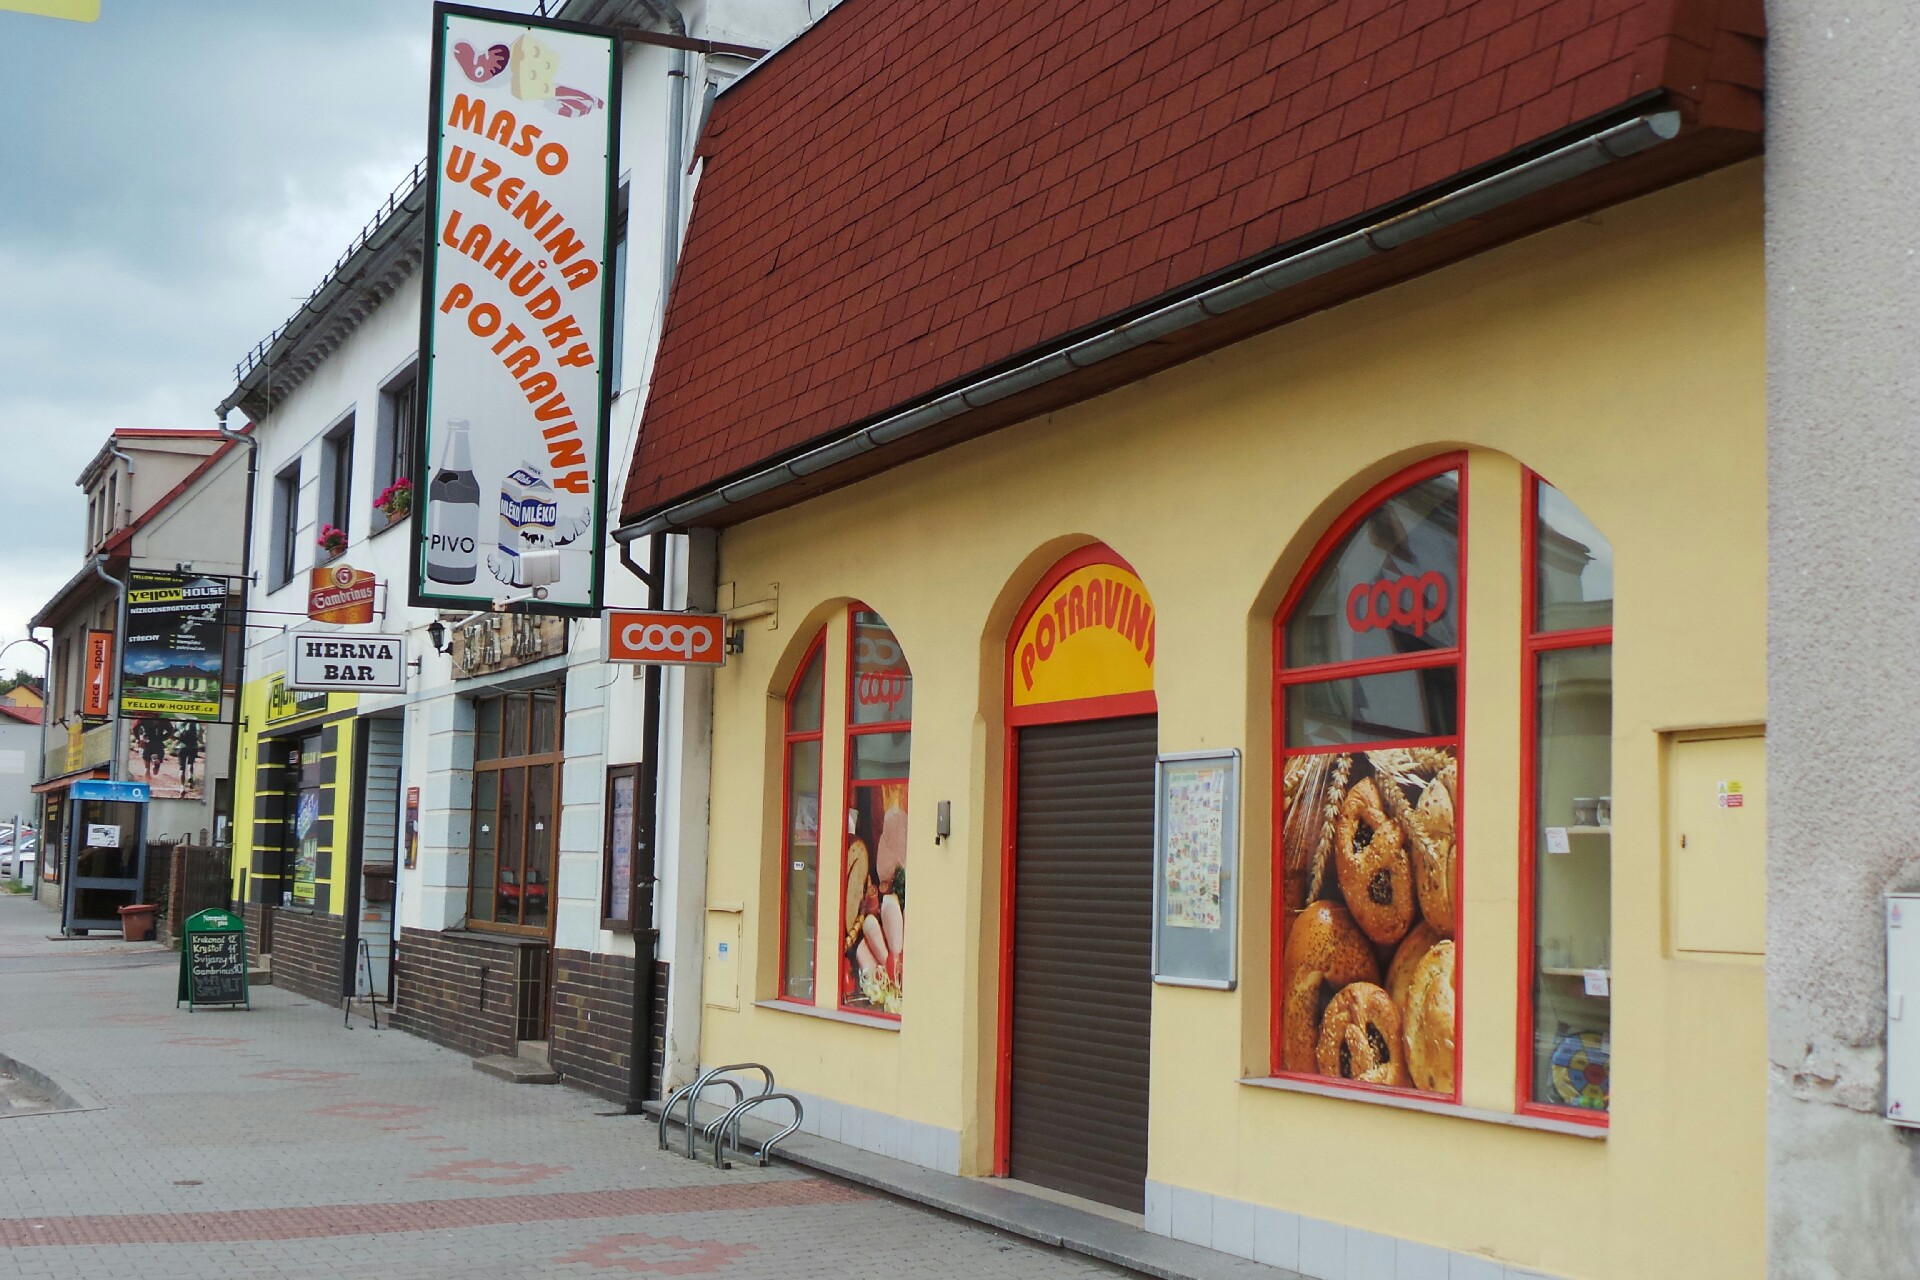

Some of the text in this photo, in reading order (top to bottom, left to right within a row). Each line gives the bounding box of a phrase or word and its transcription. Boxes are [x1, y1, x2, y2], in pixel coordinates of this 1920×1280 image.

[449, 94, 569, 176] MASO
[446, 146, 599, 291] UZENINA
[443, 210, 595, 369] LAHŮDKY
[441, 282, 590, 494] POTRAVINY
[501, 498, 520, 522] MLÉKO
[521, 503, 556, 523] MLÉKO
[430, 534, 475, 554] PIVO
[183, 586, 226, 598] HOUSE
[312, 587, 372, 609] Gambrinus
[1346, 570, 1449, 638] coop
[306, 642, 393, 660] HERNA
[621, 623, 713, 659] coop
[94, 640, 104, 670] sport
[324, 664, 375, 681] BAR
[92, 684, 101, 709] race
[858, 667, 905, 712] coop
[127, 701, 214, 713] YELLOW-HOUSE.cz
[193, 965, 235, 976] Gambrinus
